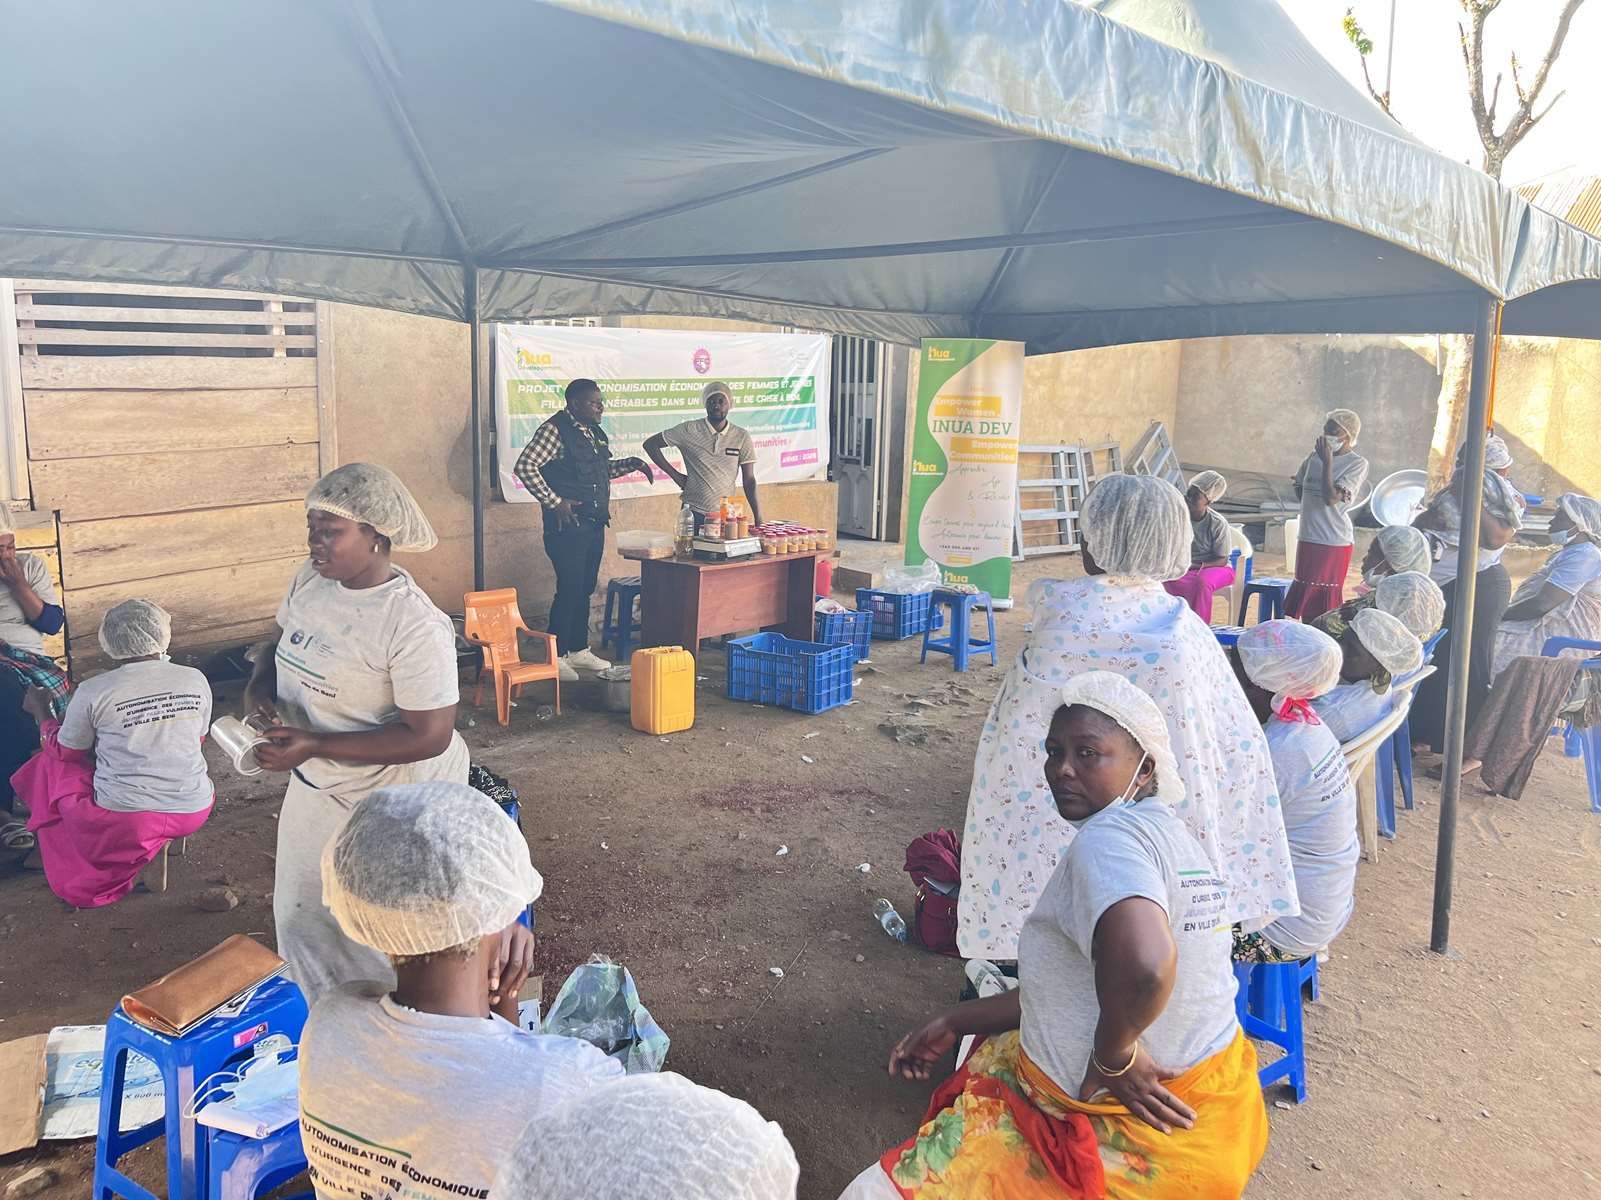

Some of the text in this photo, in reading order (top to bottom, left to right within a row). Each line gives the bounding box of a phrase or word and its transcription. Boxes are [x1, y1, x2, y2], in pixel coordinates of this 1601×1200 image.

[518, 384, 560, 394] PROJET
[598, 383, 667, 393] ONOMISATION
[670, 380, 706, 391] ÉCONOM
[729, 381, 744, 390] DES
[747, 380, 779, 390] FEMMES
[541, 399, 567, 409] FILL
[602, 396, 658, 408] NÉRABLES
[661, 397, 685, 406] DANS
[688, 396, 700, 405] UN
[932, 420, 1013, 435] INUA DEV
[116, 696, 167, 712] AUTONOMISATION
[1184, 922, 1196, 932] EN
[311, 1144, 372, 1177] D'URGENCE
[381, 1175, 403, 1193] DES
[309, 1165, 319, 1180] EN
[322, 1176, 355, 1195] VILLE
[401, 1160, 490, 1200] ÉCONOMIQUE
